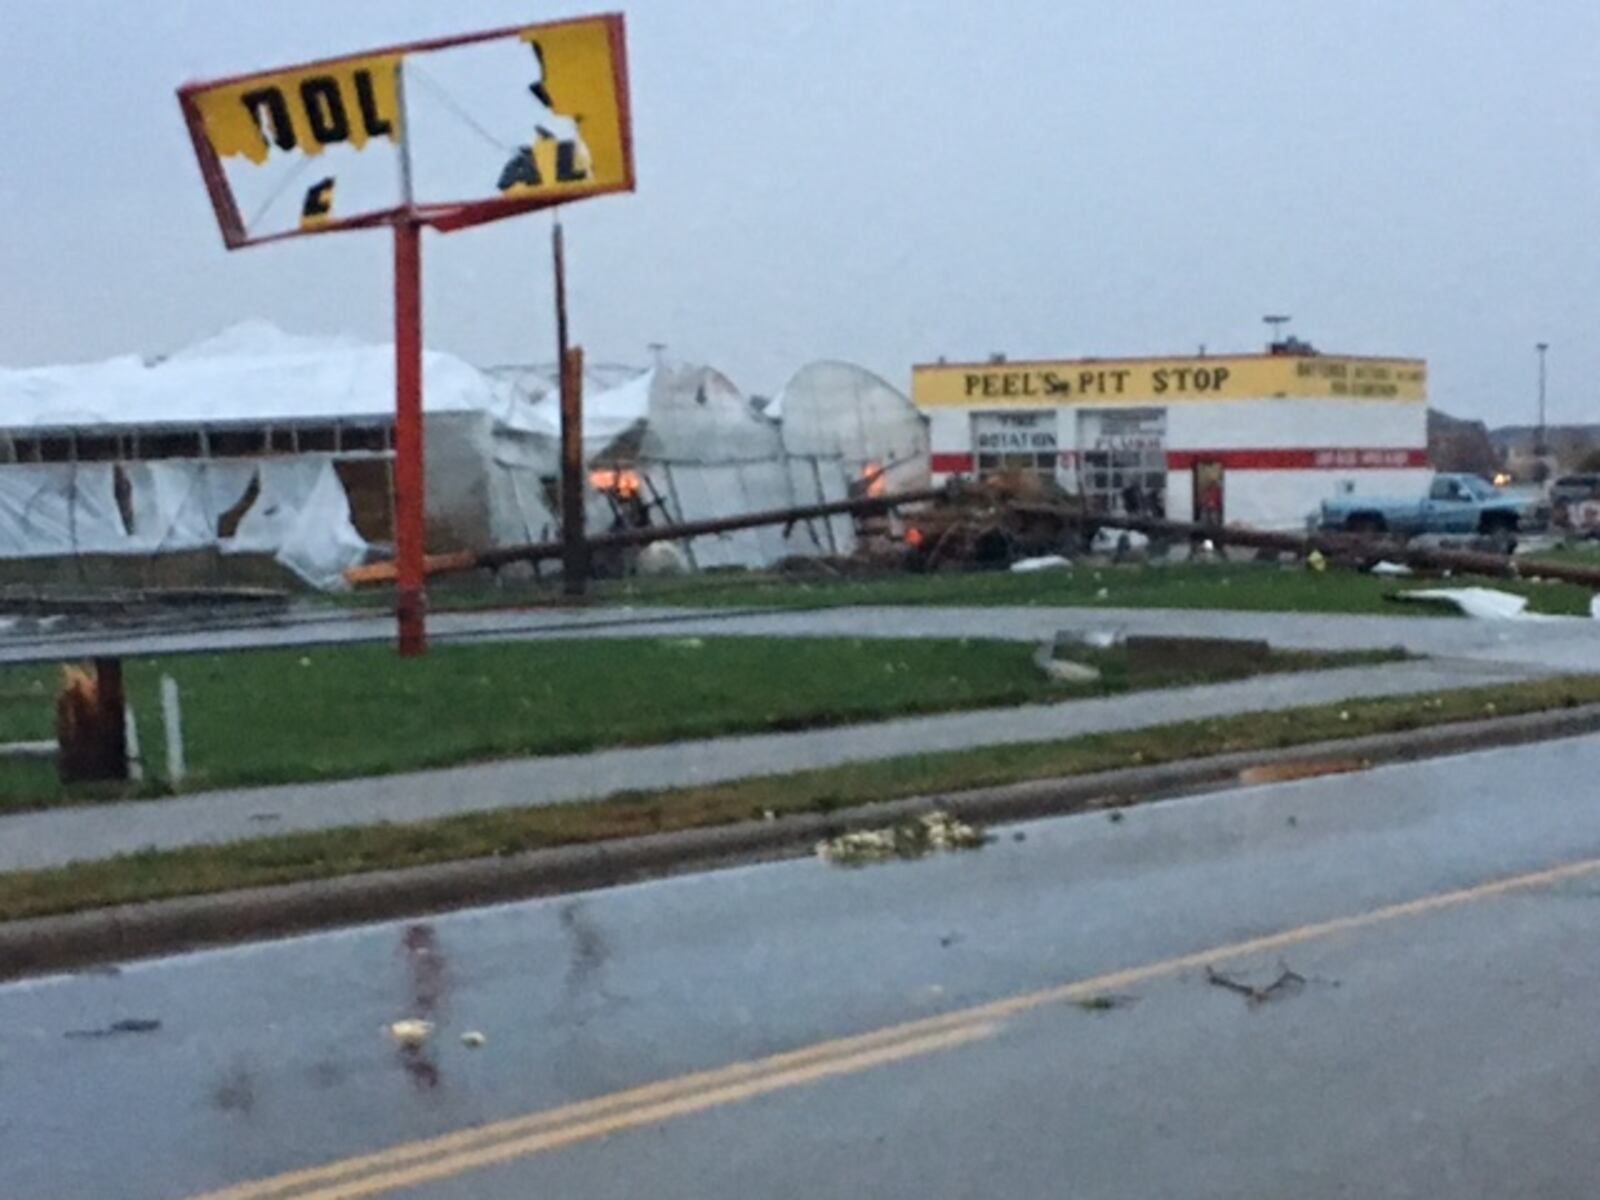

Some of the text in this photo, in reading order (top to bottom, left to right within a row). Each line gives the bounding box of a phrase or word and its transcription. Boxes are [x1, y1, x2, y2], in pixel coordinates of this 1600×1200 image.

[965, 367, 1230, 397] PEEL'S PIT STOP
